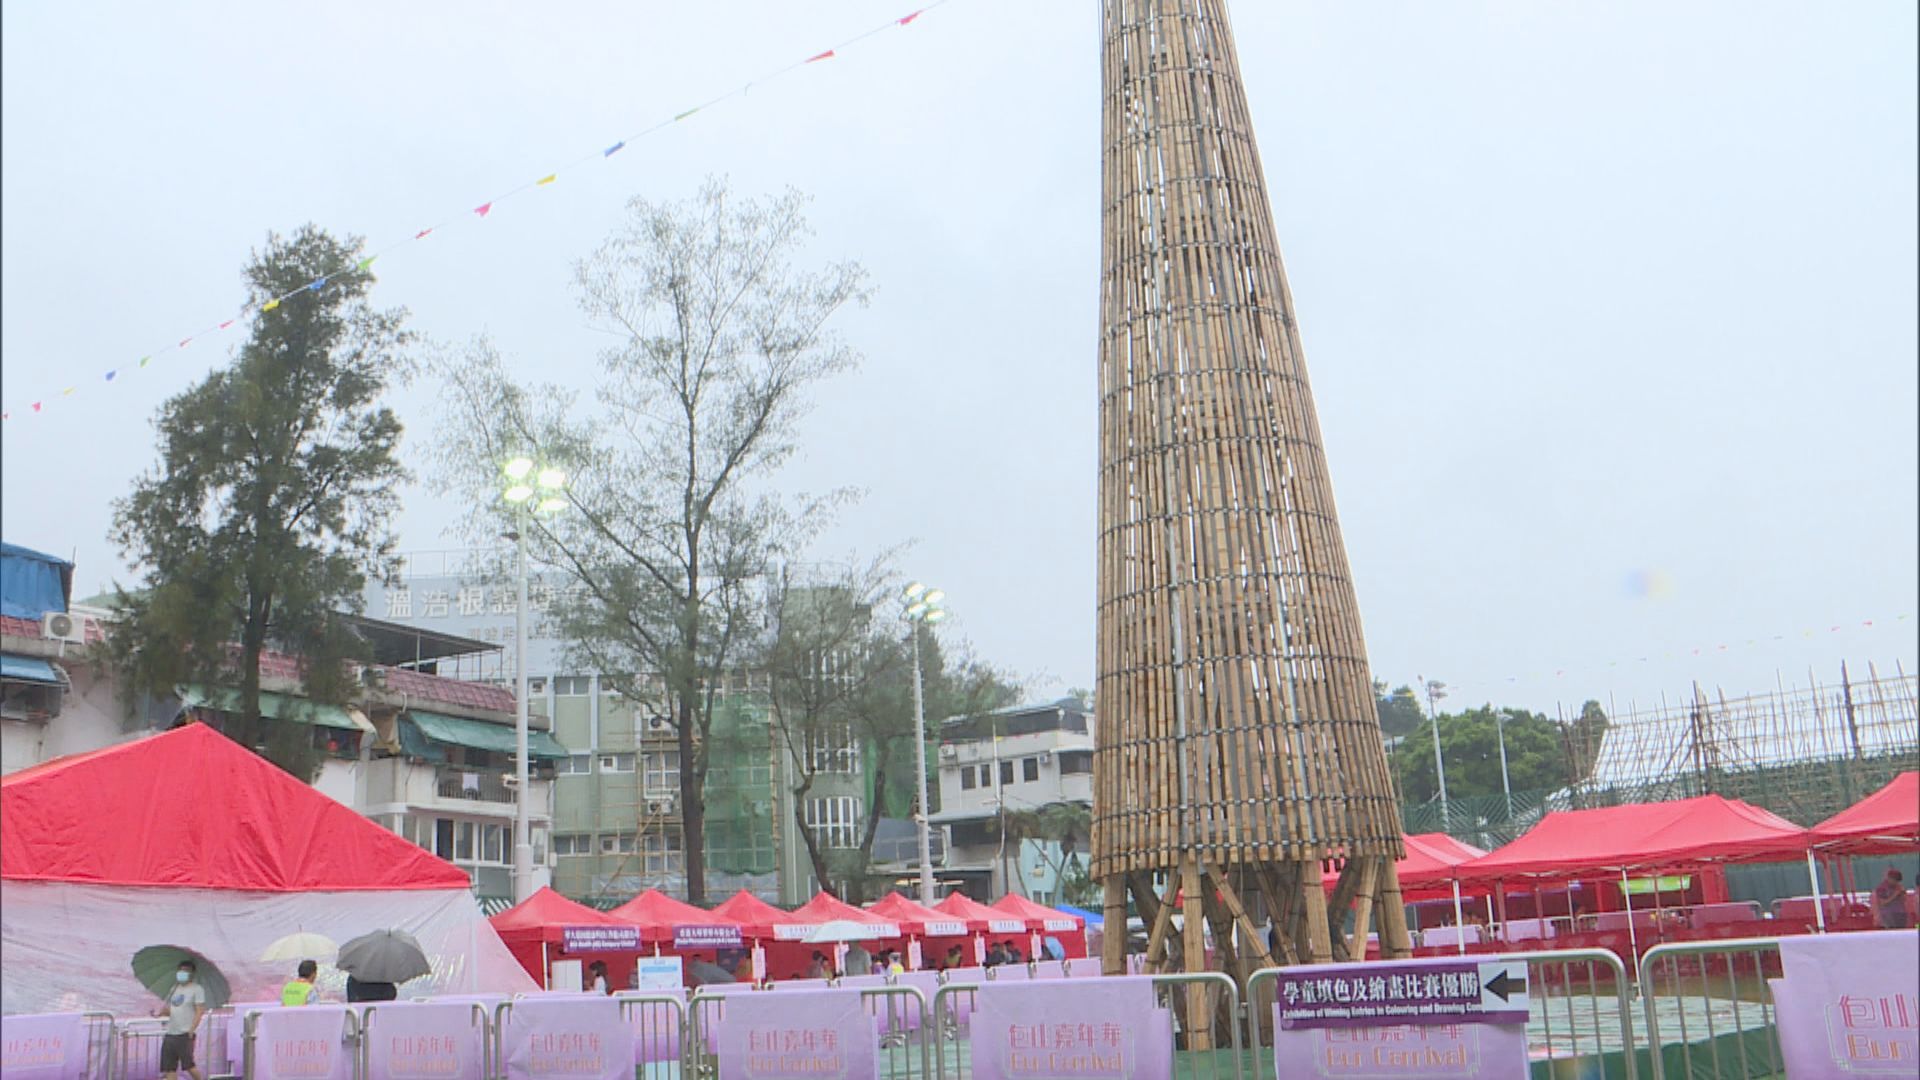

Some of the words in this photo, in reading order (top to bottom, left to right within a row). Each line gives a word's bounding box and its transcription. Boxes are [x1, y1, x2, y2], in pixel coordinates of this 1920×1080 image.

[1283, 972, 1479, 1005] 學童填色及繪畫比賽優勝
[1283, 1007, 1315, 1019] Exhibition
[1316, 1007, 1324, 1017] of
[1324, 1007, 1351, 1019] Winning
[1351, 1005, 1376, 1017] Entries
[1385, 1003, 1418, 1016] Colouring
[1419, 1003, 1433, 1014] and
[1434, 1002, 1466, 1015] Drawing
[1373, 1044, 1467, 1070] Carnival
[1847, 1034, 1913, 1060] Bun
